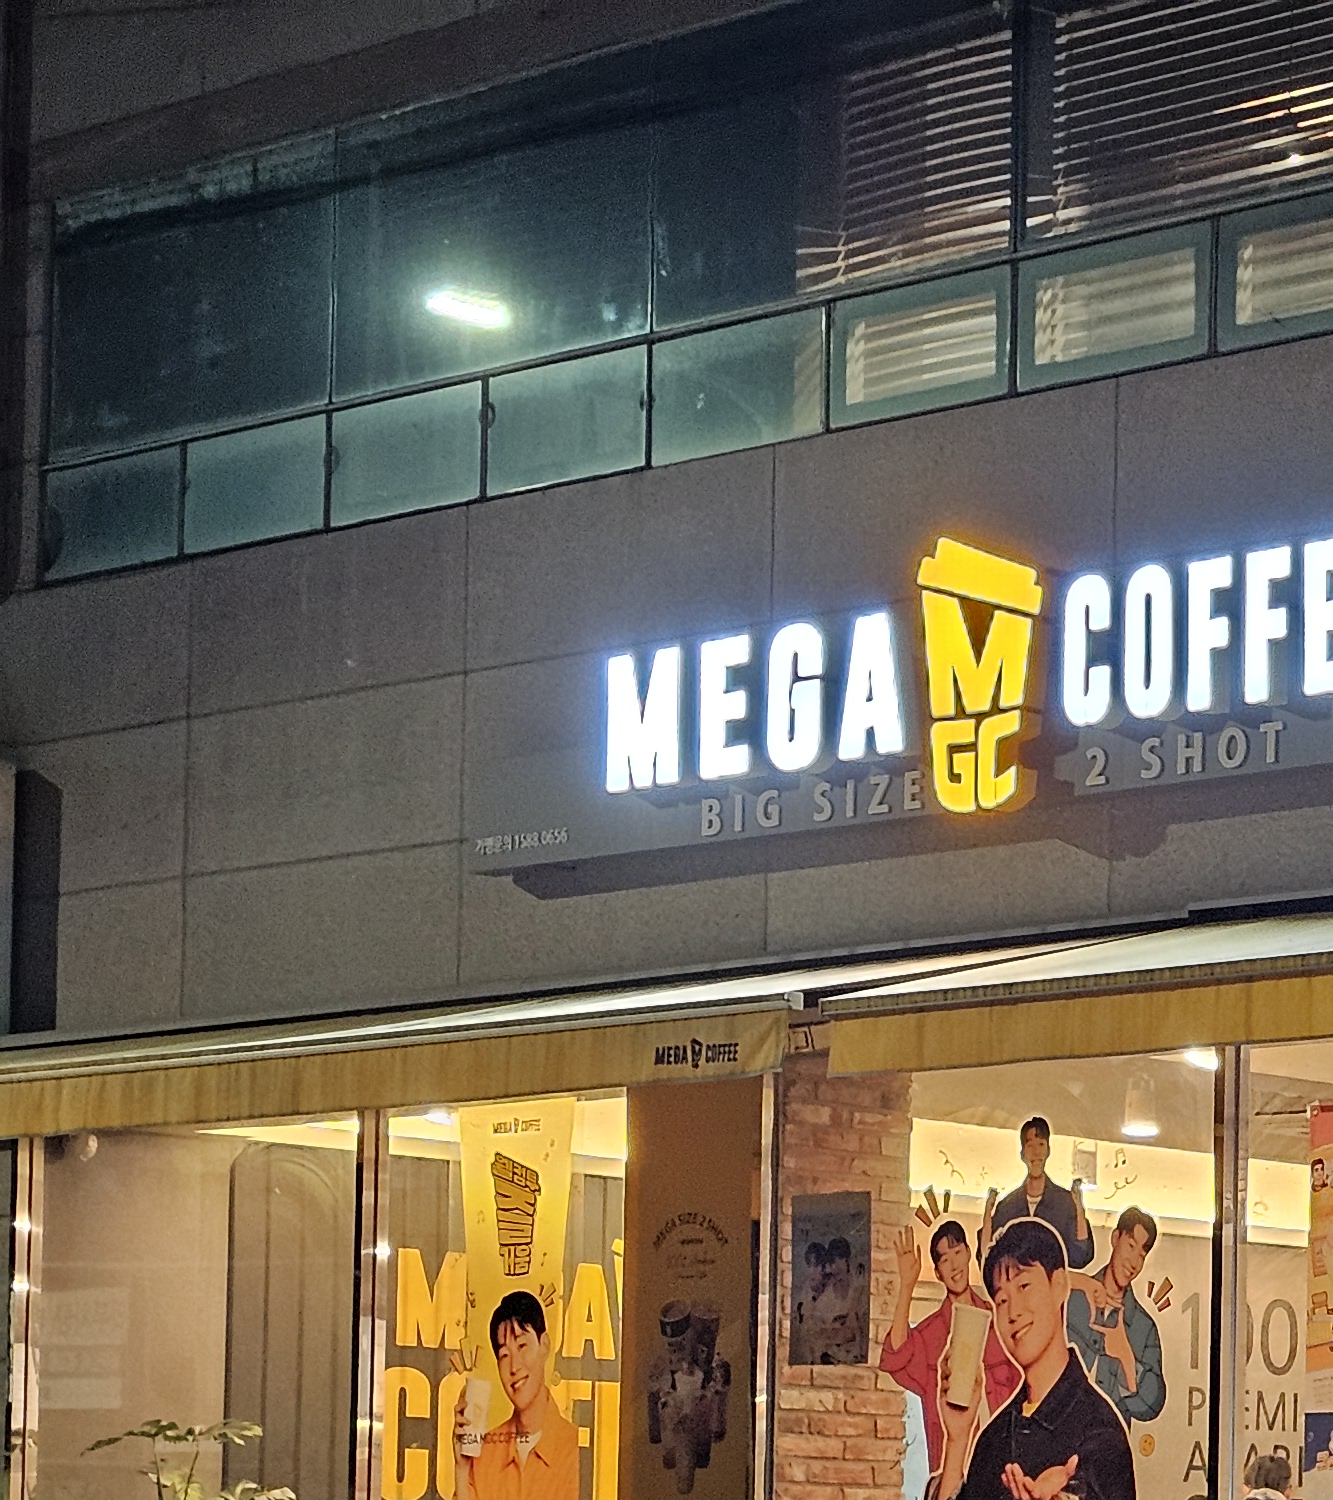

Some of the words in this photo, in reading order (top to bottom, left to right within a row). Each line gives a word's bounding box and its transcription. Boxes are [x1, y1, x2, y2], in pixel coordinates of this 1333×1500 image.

[606, 611, 904, 794] MEGA
[1085, 747, 1109, 786] 2
[1141, 721, 1286, 779] SHOT
[702, 786, 781, 836] BIG
[815, 770, 923, 820] SIZE
[705, 1042, 739, 1064] COFFEE
